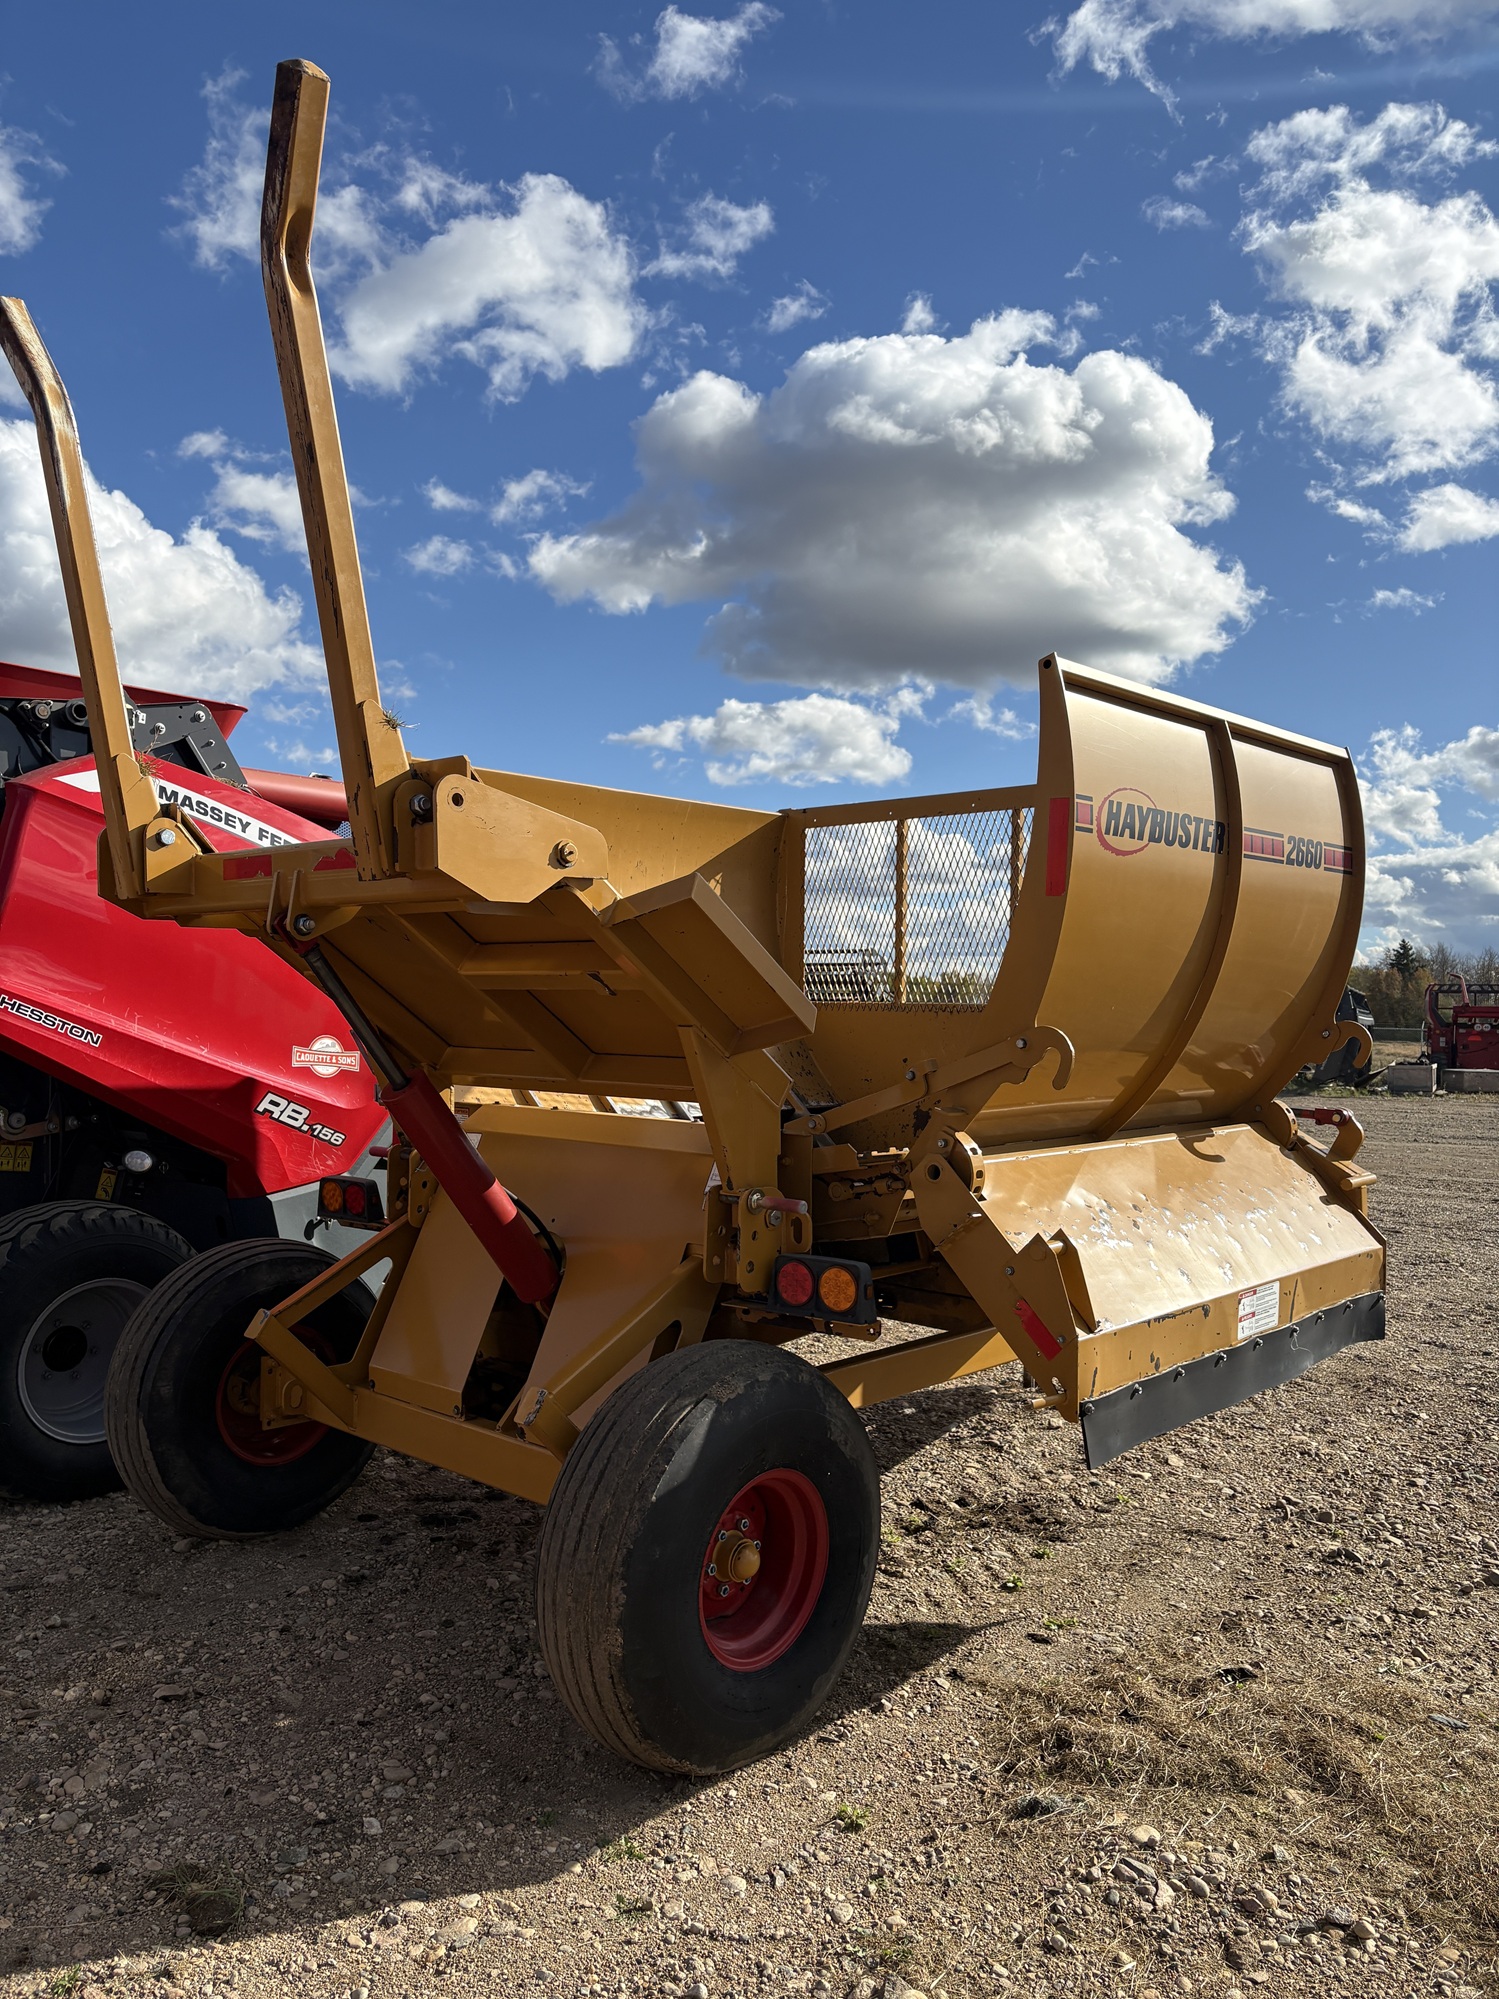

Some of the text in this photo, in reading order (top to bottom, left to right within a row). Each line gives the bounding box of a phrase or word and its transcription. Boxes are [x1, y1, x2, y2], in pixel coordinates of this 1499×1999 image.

[158, 784, 251, 834] MASSEY
[1104, 799, 1226, 855] HAYBUSTER
[1285, 836, 1323, 870] 2660
[0, 995, 102, 1047] HESSTON
[296, 1052, 356, 1066] CAOUETTE & SONS
